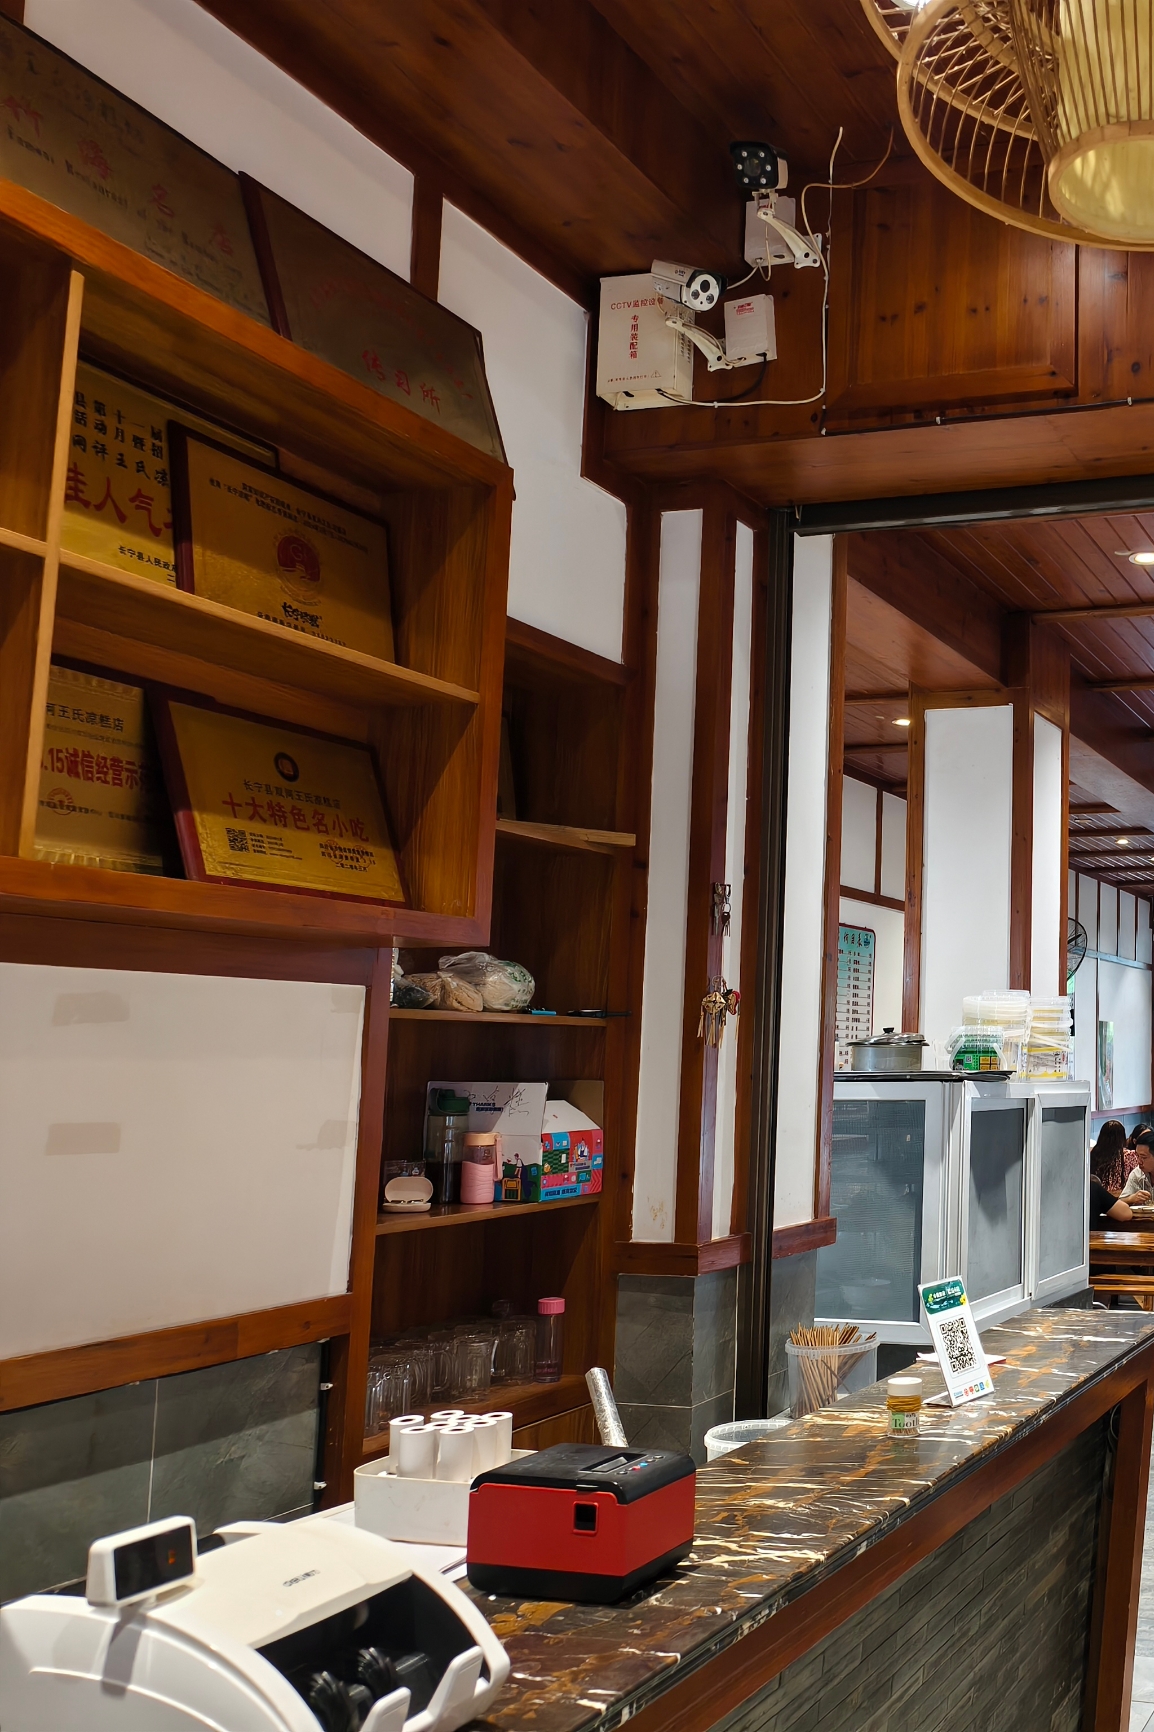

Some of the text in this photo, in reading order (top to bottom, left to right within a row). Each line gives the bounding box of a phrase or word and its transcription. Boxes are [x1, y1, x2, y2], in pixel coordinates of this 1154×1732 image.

[629, 314, 640, 360] 专用装配箱
[361, 347, 441, 416] 传习所
[222, 792, 370, 843] 十大特色名小吃
